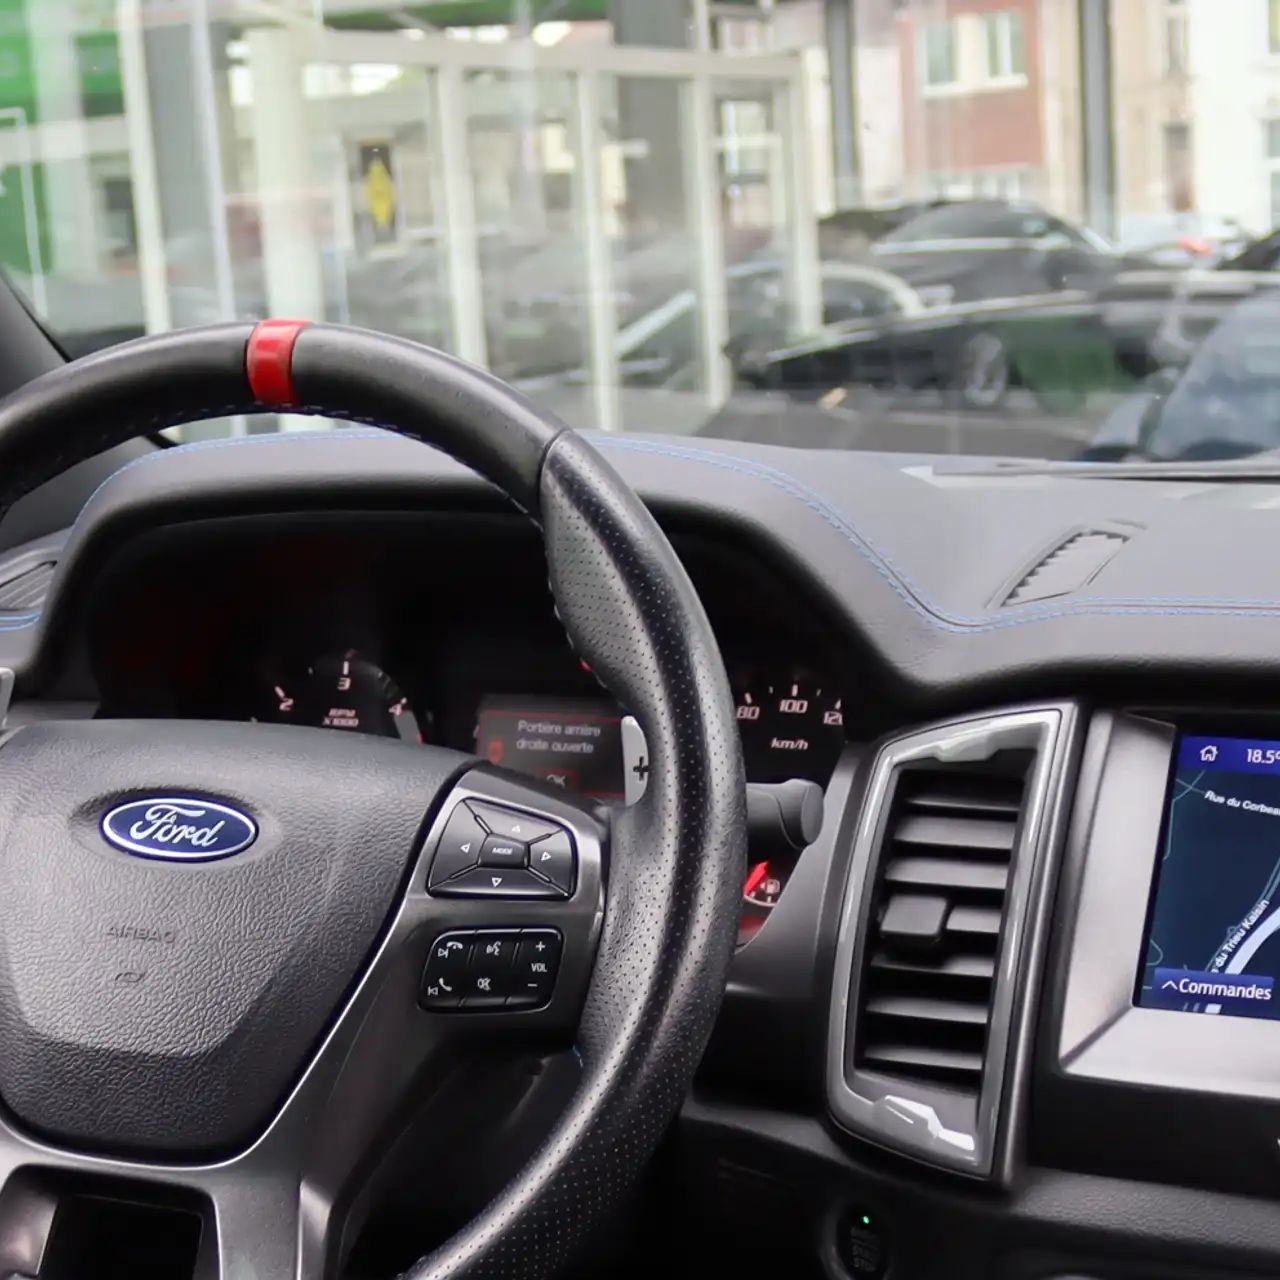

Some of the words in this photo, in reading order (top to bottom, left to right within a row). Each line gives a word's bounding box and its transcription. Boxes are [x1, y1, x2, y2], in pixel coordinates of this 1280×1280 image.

[337, 677, 351, 690] 3
[279, 699, 294, 711] 2
[736, 705, 760, 719] 80
[779, 699, 808, 713] 100
[516, 738, 549, 750] droite
[551, 740, 594, 753] ouverte
[770, 737, 809, 750] km/h
[1204, 789, 1225, 805] Rue
[1226, 797, 1241, 808] du
[129, 803, 225, 848] Ford
[1215, 952, 1228, 968] du
[1222, 927, 1247, 953] Trieu
[531, 962, 547, 973] VOL
[1179, 978, 1272, 1001] Commandes
